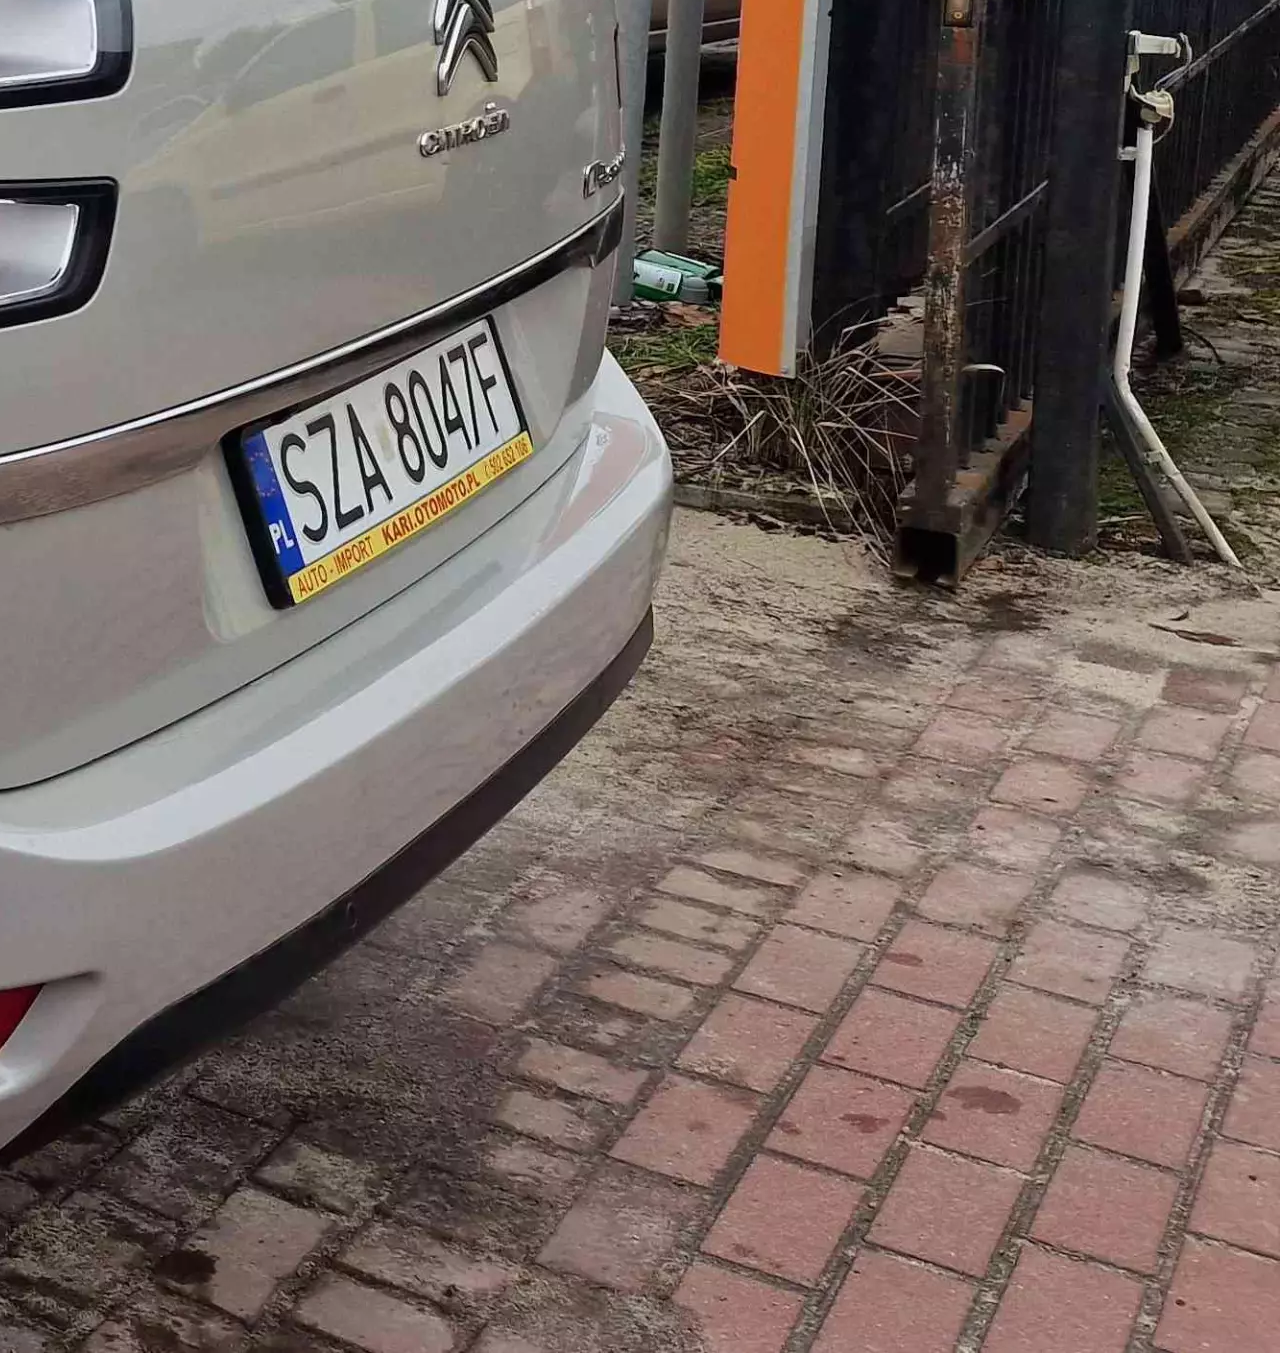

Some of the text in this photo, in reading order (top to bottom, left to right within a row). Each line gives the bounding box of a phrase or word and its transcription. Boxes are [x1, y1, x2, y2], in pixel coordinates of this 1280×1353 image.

[280, 332, 498, 543] SZA 8047F
[270, 521, 294, 555] PL
[297, 565, 328, 598] AUTO
[333, 536, 374, 575] IMPORT
[381, 473, 481, 545] KARI.OTOMOTO.PL
